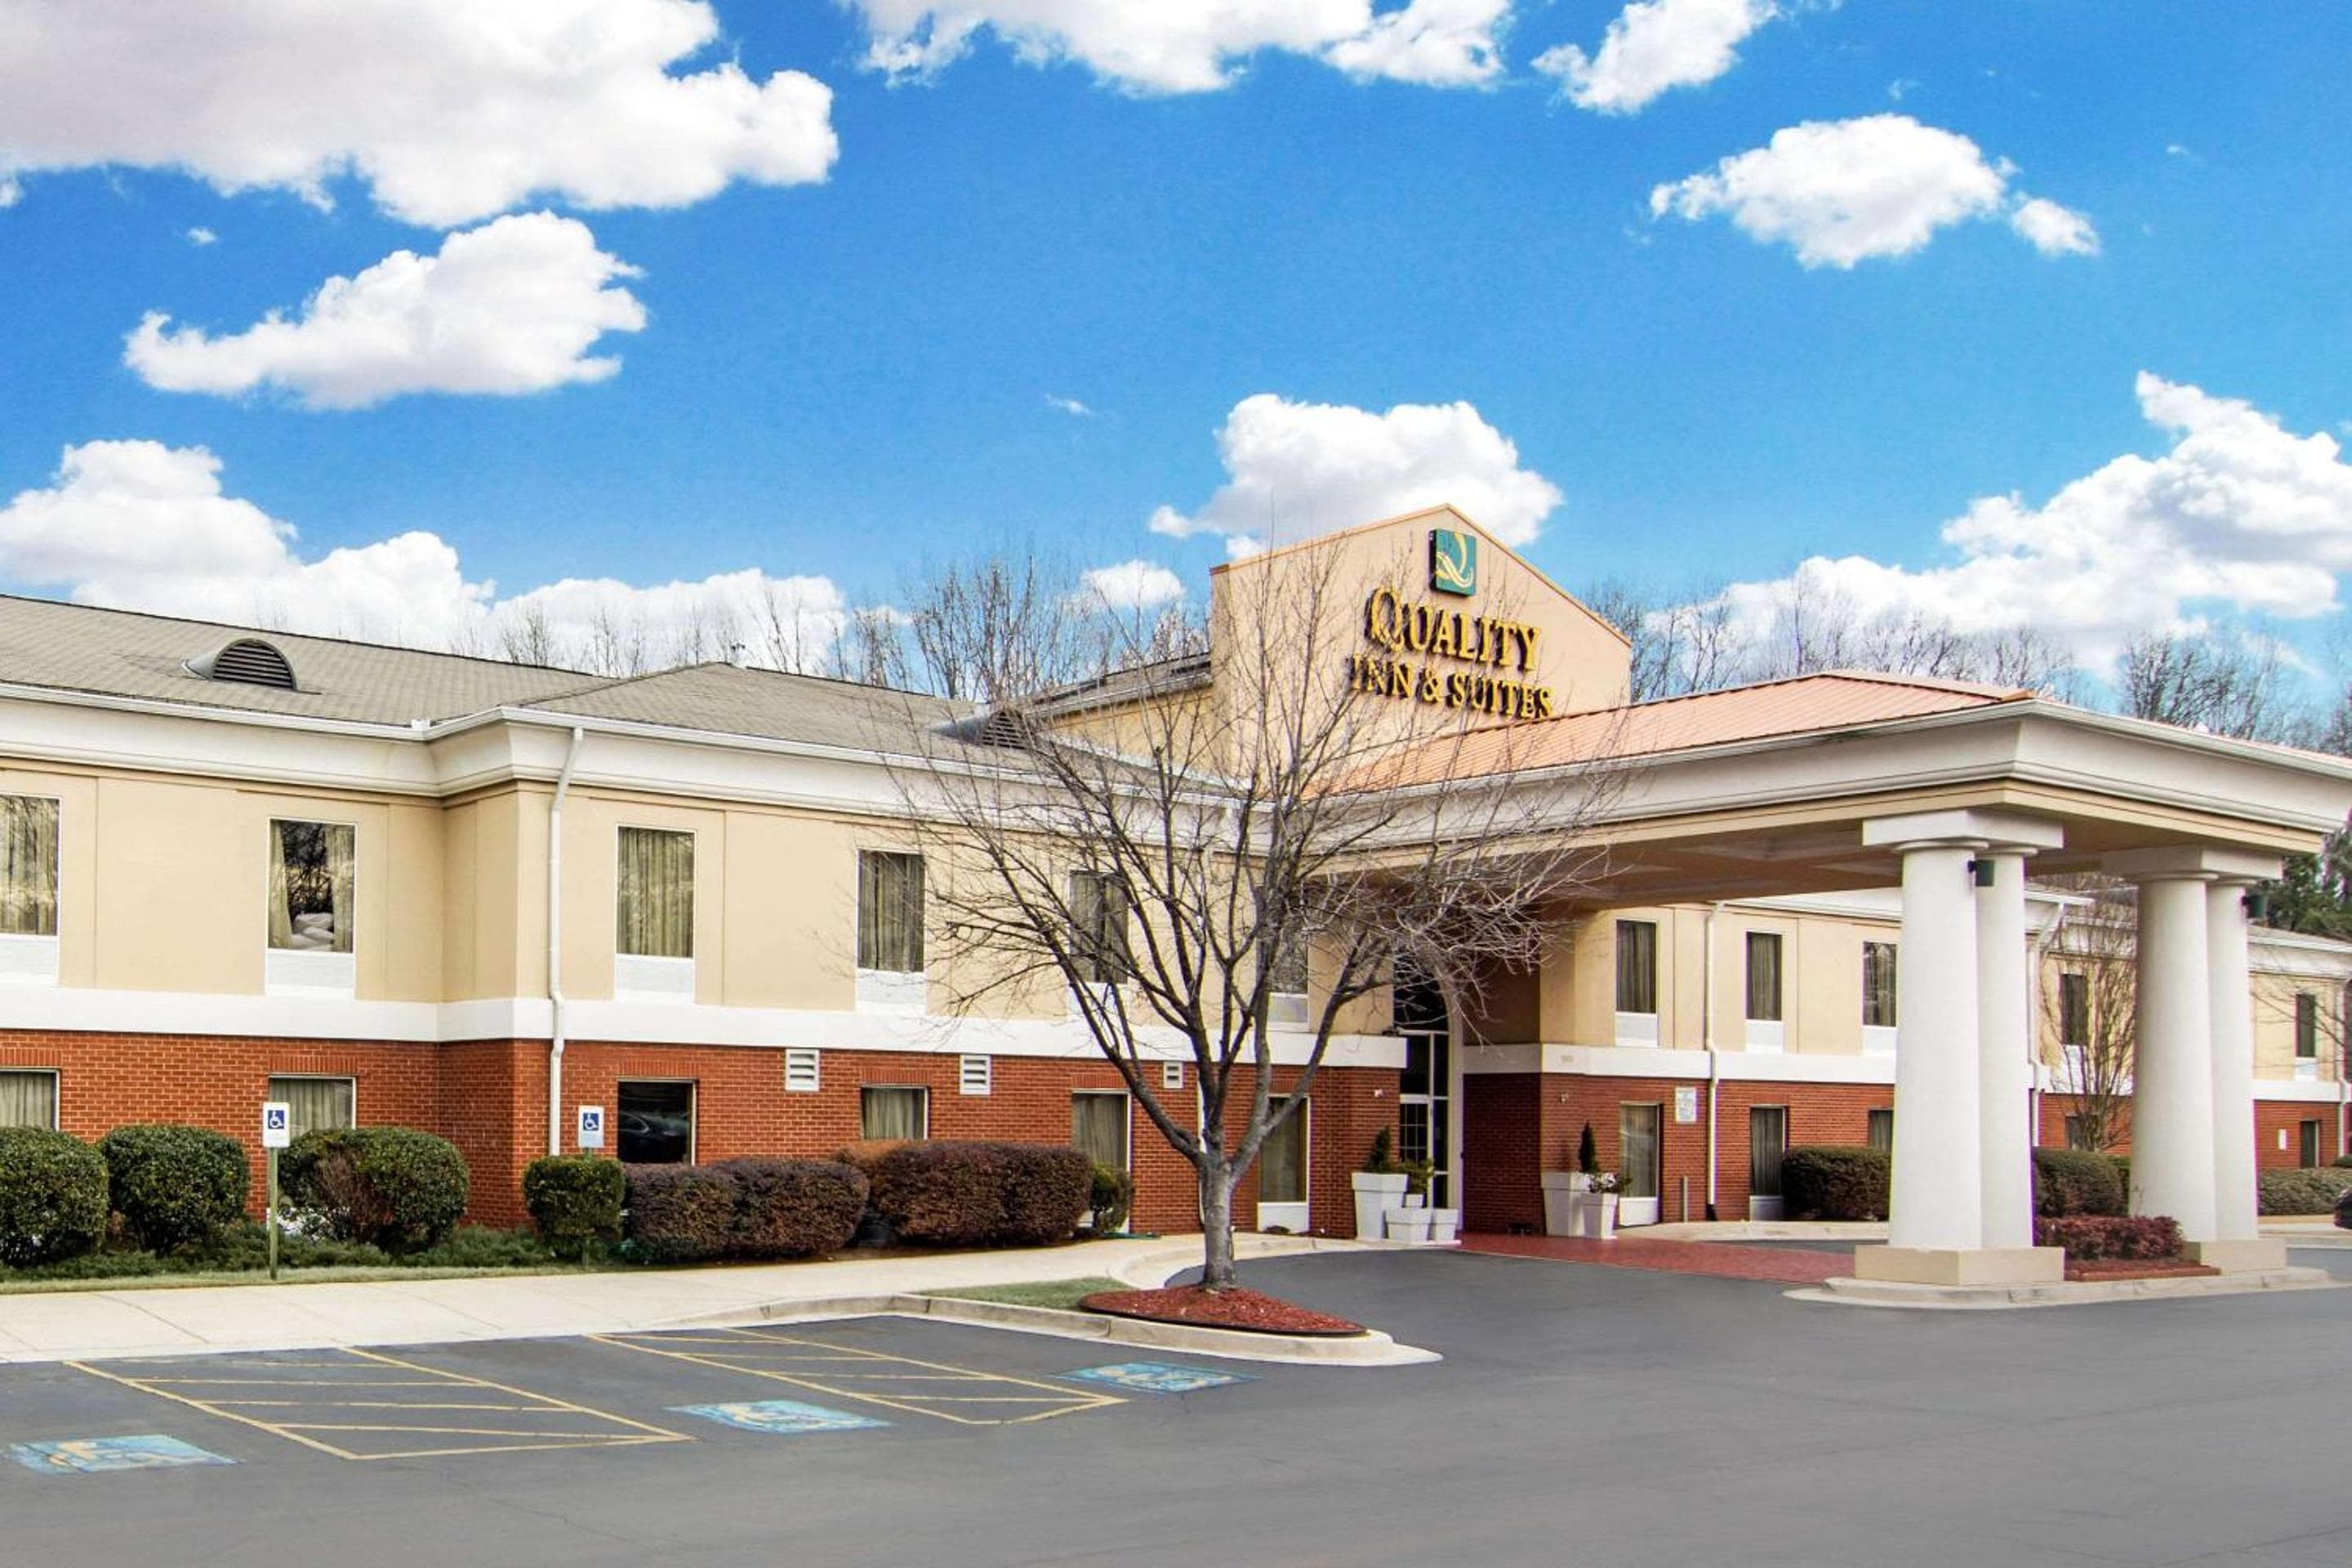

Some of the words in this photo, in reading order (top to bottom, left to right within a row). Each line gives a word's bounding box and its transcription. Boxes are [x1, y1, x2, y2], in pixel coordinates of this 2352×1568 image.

[1367, 587, 1539, 670] QUALITY
[1351, 655, 1412, 697] INN
[1422, 667, 1442, 702] &
[1447, 672, 1554, 720] SUITES
